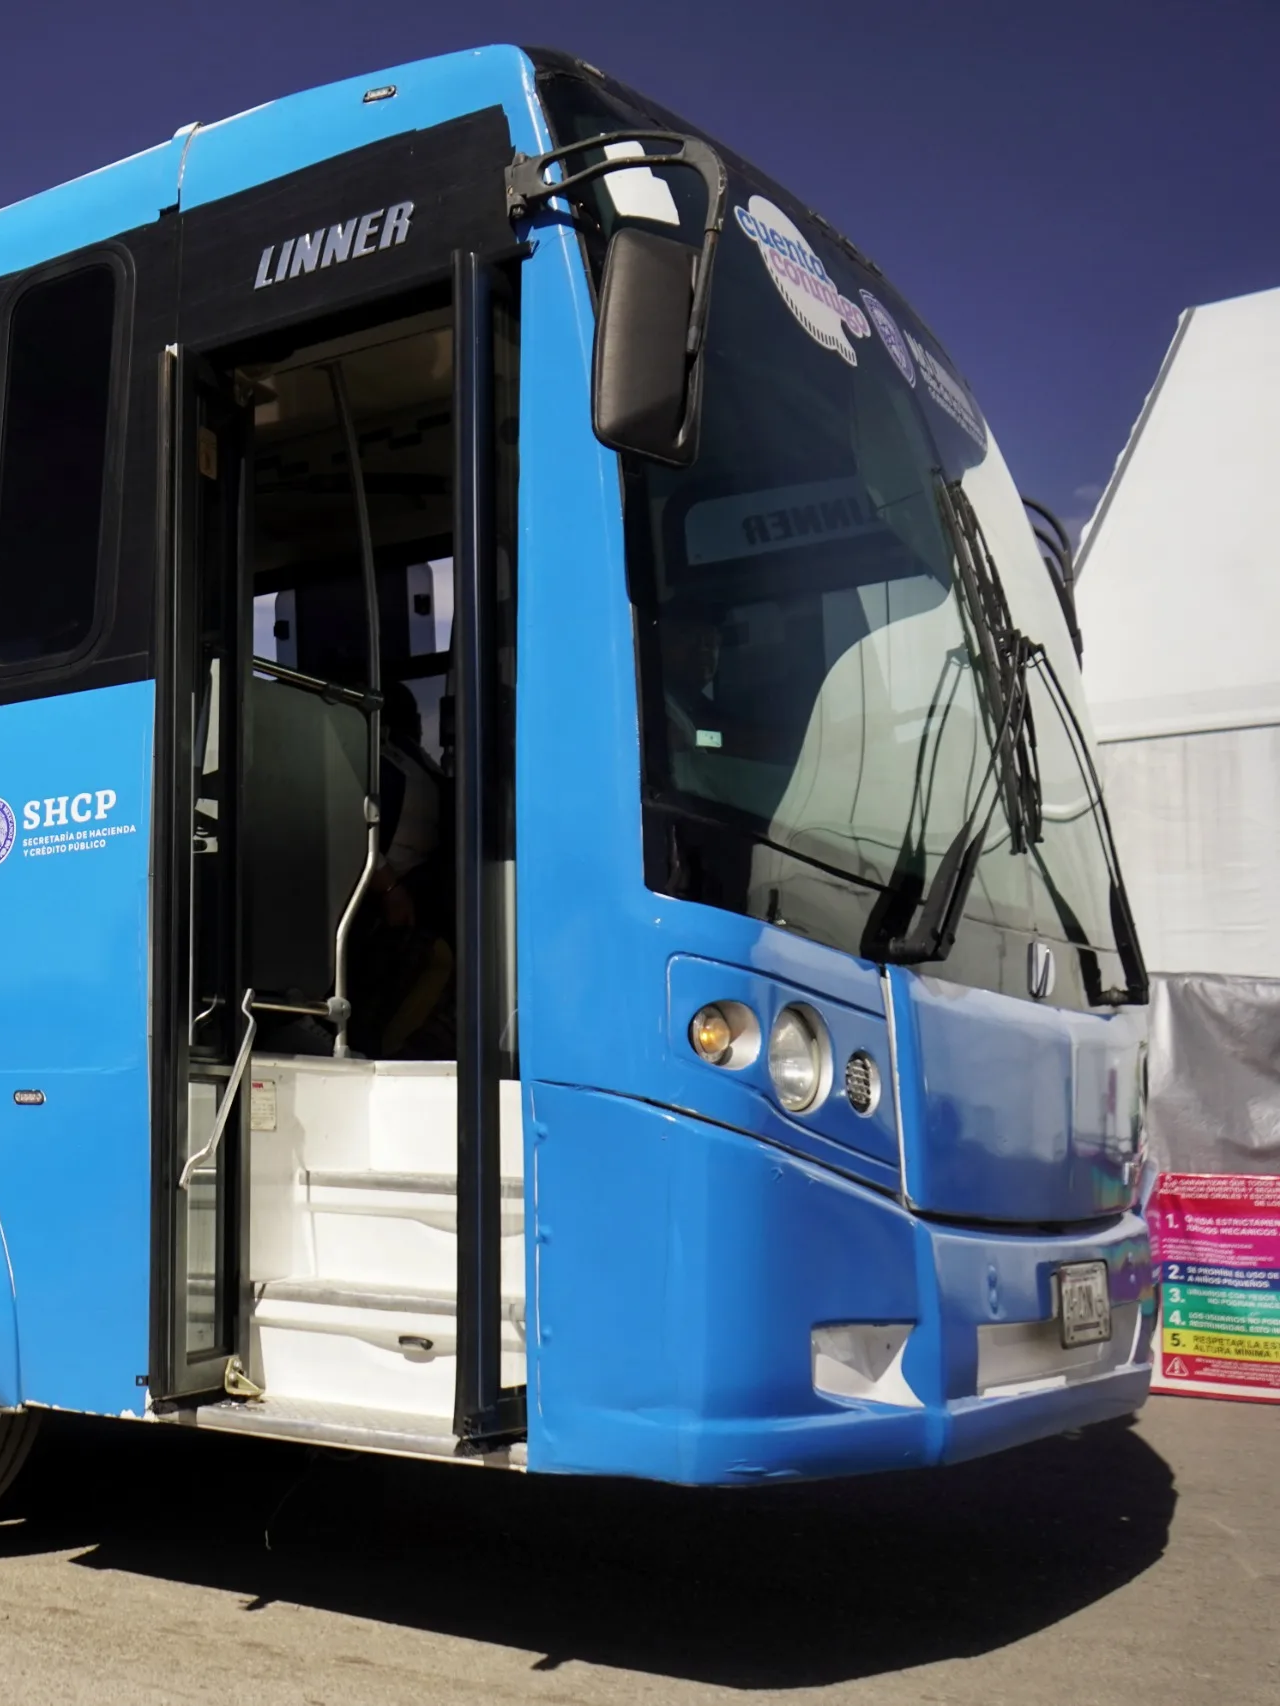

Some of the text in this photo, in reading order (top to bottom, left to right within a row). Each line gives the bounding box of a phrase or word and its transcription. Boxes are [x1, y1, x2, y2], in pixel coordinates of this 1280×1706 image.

[253, 200, 415, 290] LINNER
[736, 207, 831, 284] cuenta
[769, 249, 867, 335] conmigo
[23, 790, 116, 830] SHCP
[23, 824, 137, 847] SECRETARÍA DE HACIENDA
[23, 840, 107, 858] Y CRÉDITO PÚBLICO
[1165, 1213, 1179, 1229] 1.
[1168, 1264, 1185, 1280] 2.
[1168, 1288, 1185, 1303] 3.
[1169, 1310, 1186, 1325] 4.
[1171, 1333, 1186, 1348] 5.
[1193, 1335, 1244, 1346] RESPETAR
[1193, 1344, 1231, 1355] ALTURA
